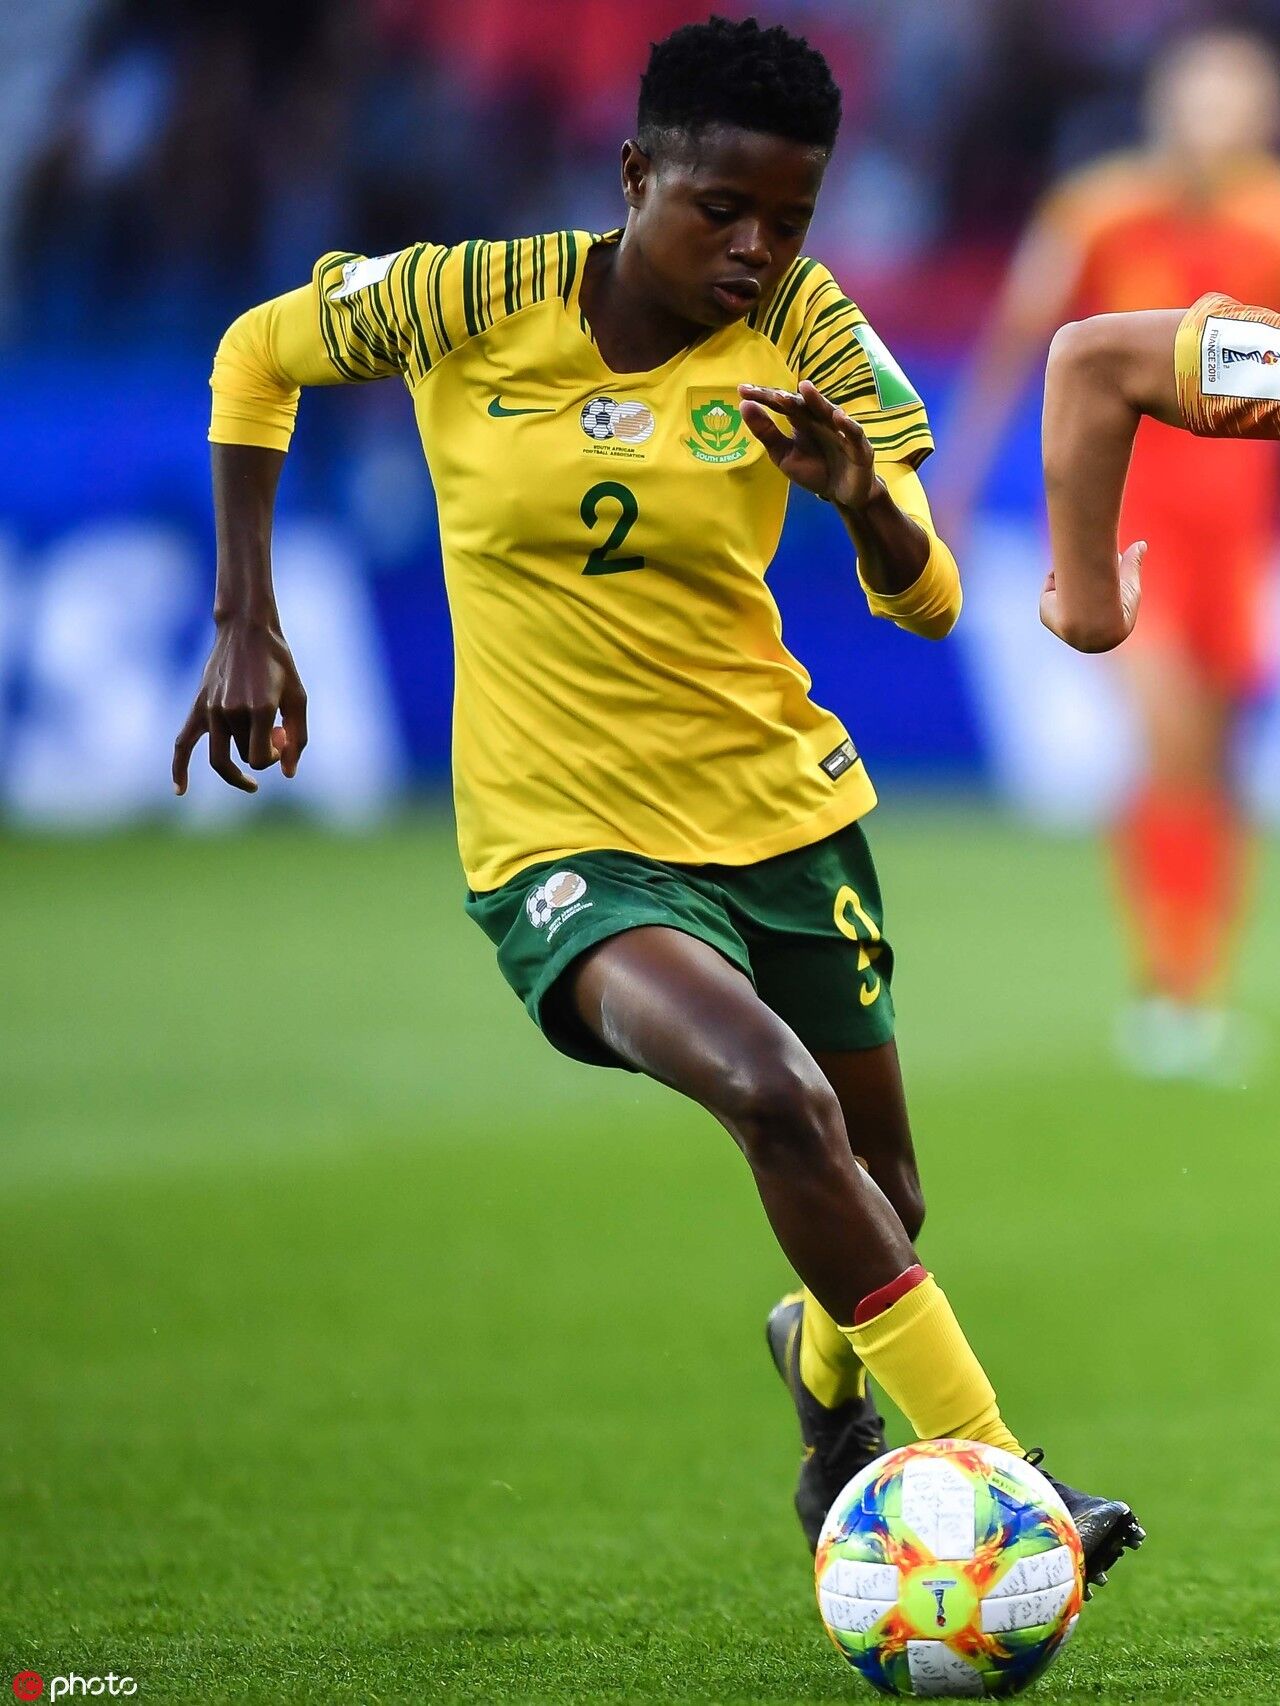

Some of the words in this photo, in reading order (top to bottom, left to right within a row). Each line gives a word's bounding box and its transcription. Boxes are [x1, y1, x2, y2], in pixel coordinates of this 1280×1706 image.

[1208, 329, 1219, 363] FRANCE
[1208, 364, 1216, 383] 2019
[696, 451, 719, 462] SOUTH
[719, 451, 742, 463] AFRICA
[580, 481, 645, 576] 2
